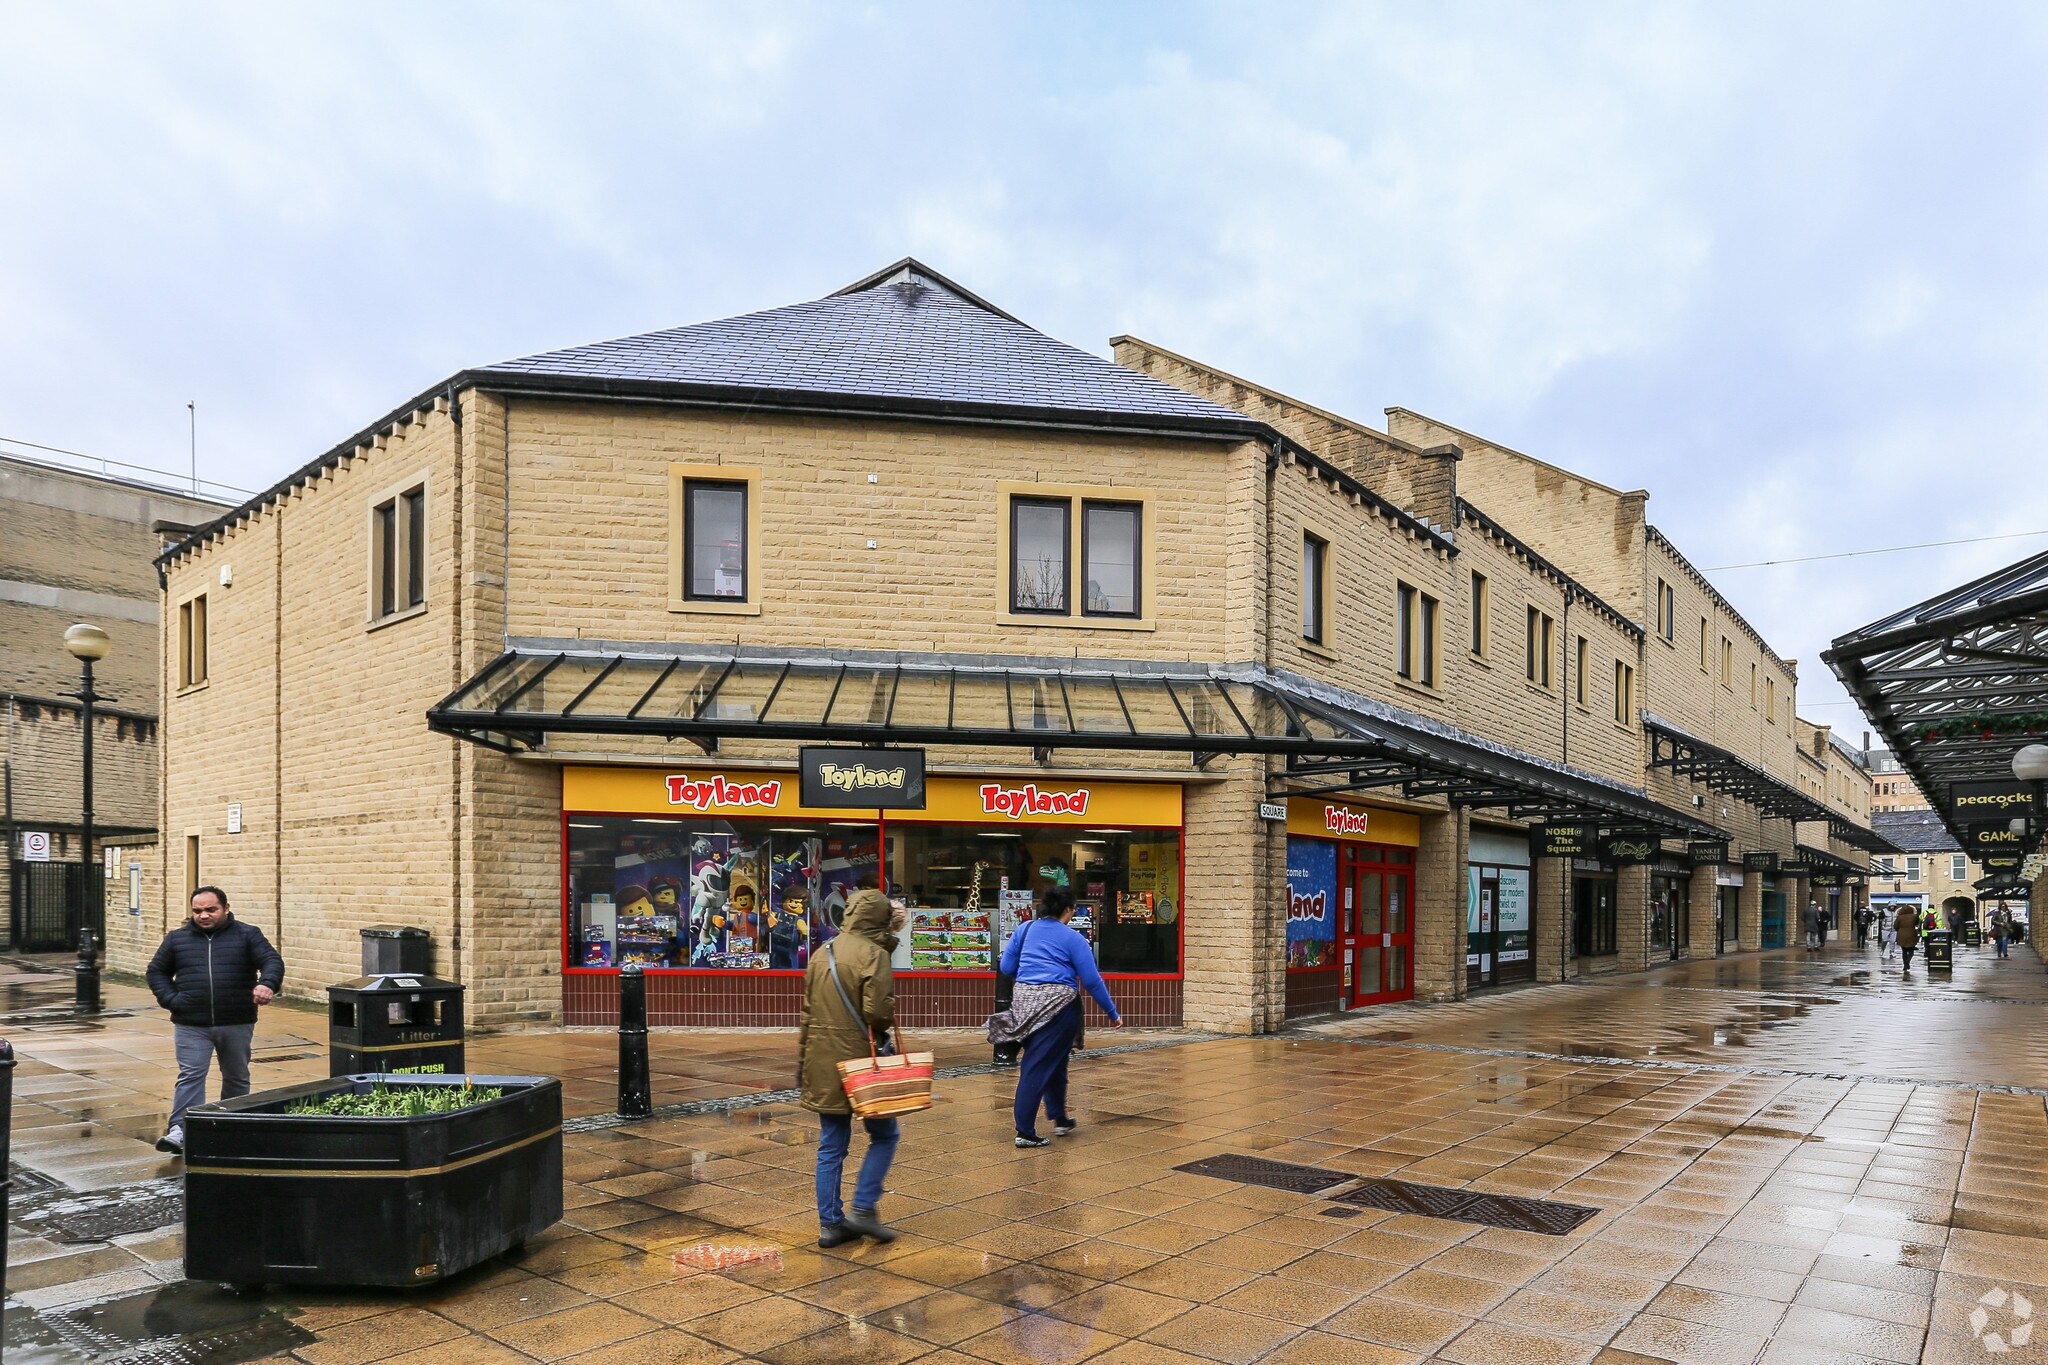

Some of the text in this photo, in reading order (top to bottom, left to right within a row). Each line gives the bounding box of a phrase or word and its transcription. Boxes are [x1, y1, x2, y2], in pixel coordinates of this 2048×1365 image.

[819, 763, 906, 792] Toyland
[665, 774, 782, 811] Toyland
[980, 783, 1090, 820] Toyland
[1956, 793, 2033, 809] peacocks
[1262, 805, 1285, 818] SQUARE
[1324, 805, 1368, 836] Toyland
[1545, 828, 1583, 837] NOSH@
[1978, 831, 2020, 842] GAME
[1555, 837, 1573, 845] The
[1546, 845, 1582, 854] Square
[1302, 868, 1309, 878] to
[1508, 887, 1525, 897] modern
[400, 1031, 436, 1042] Litter
[392, 1063, 445, 1074] DON'T PUSH
